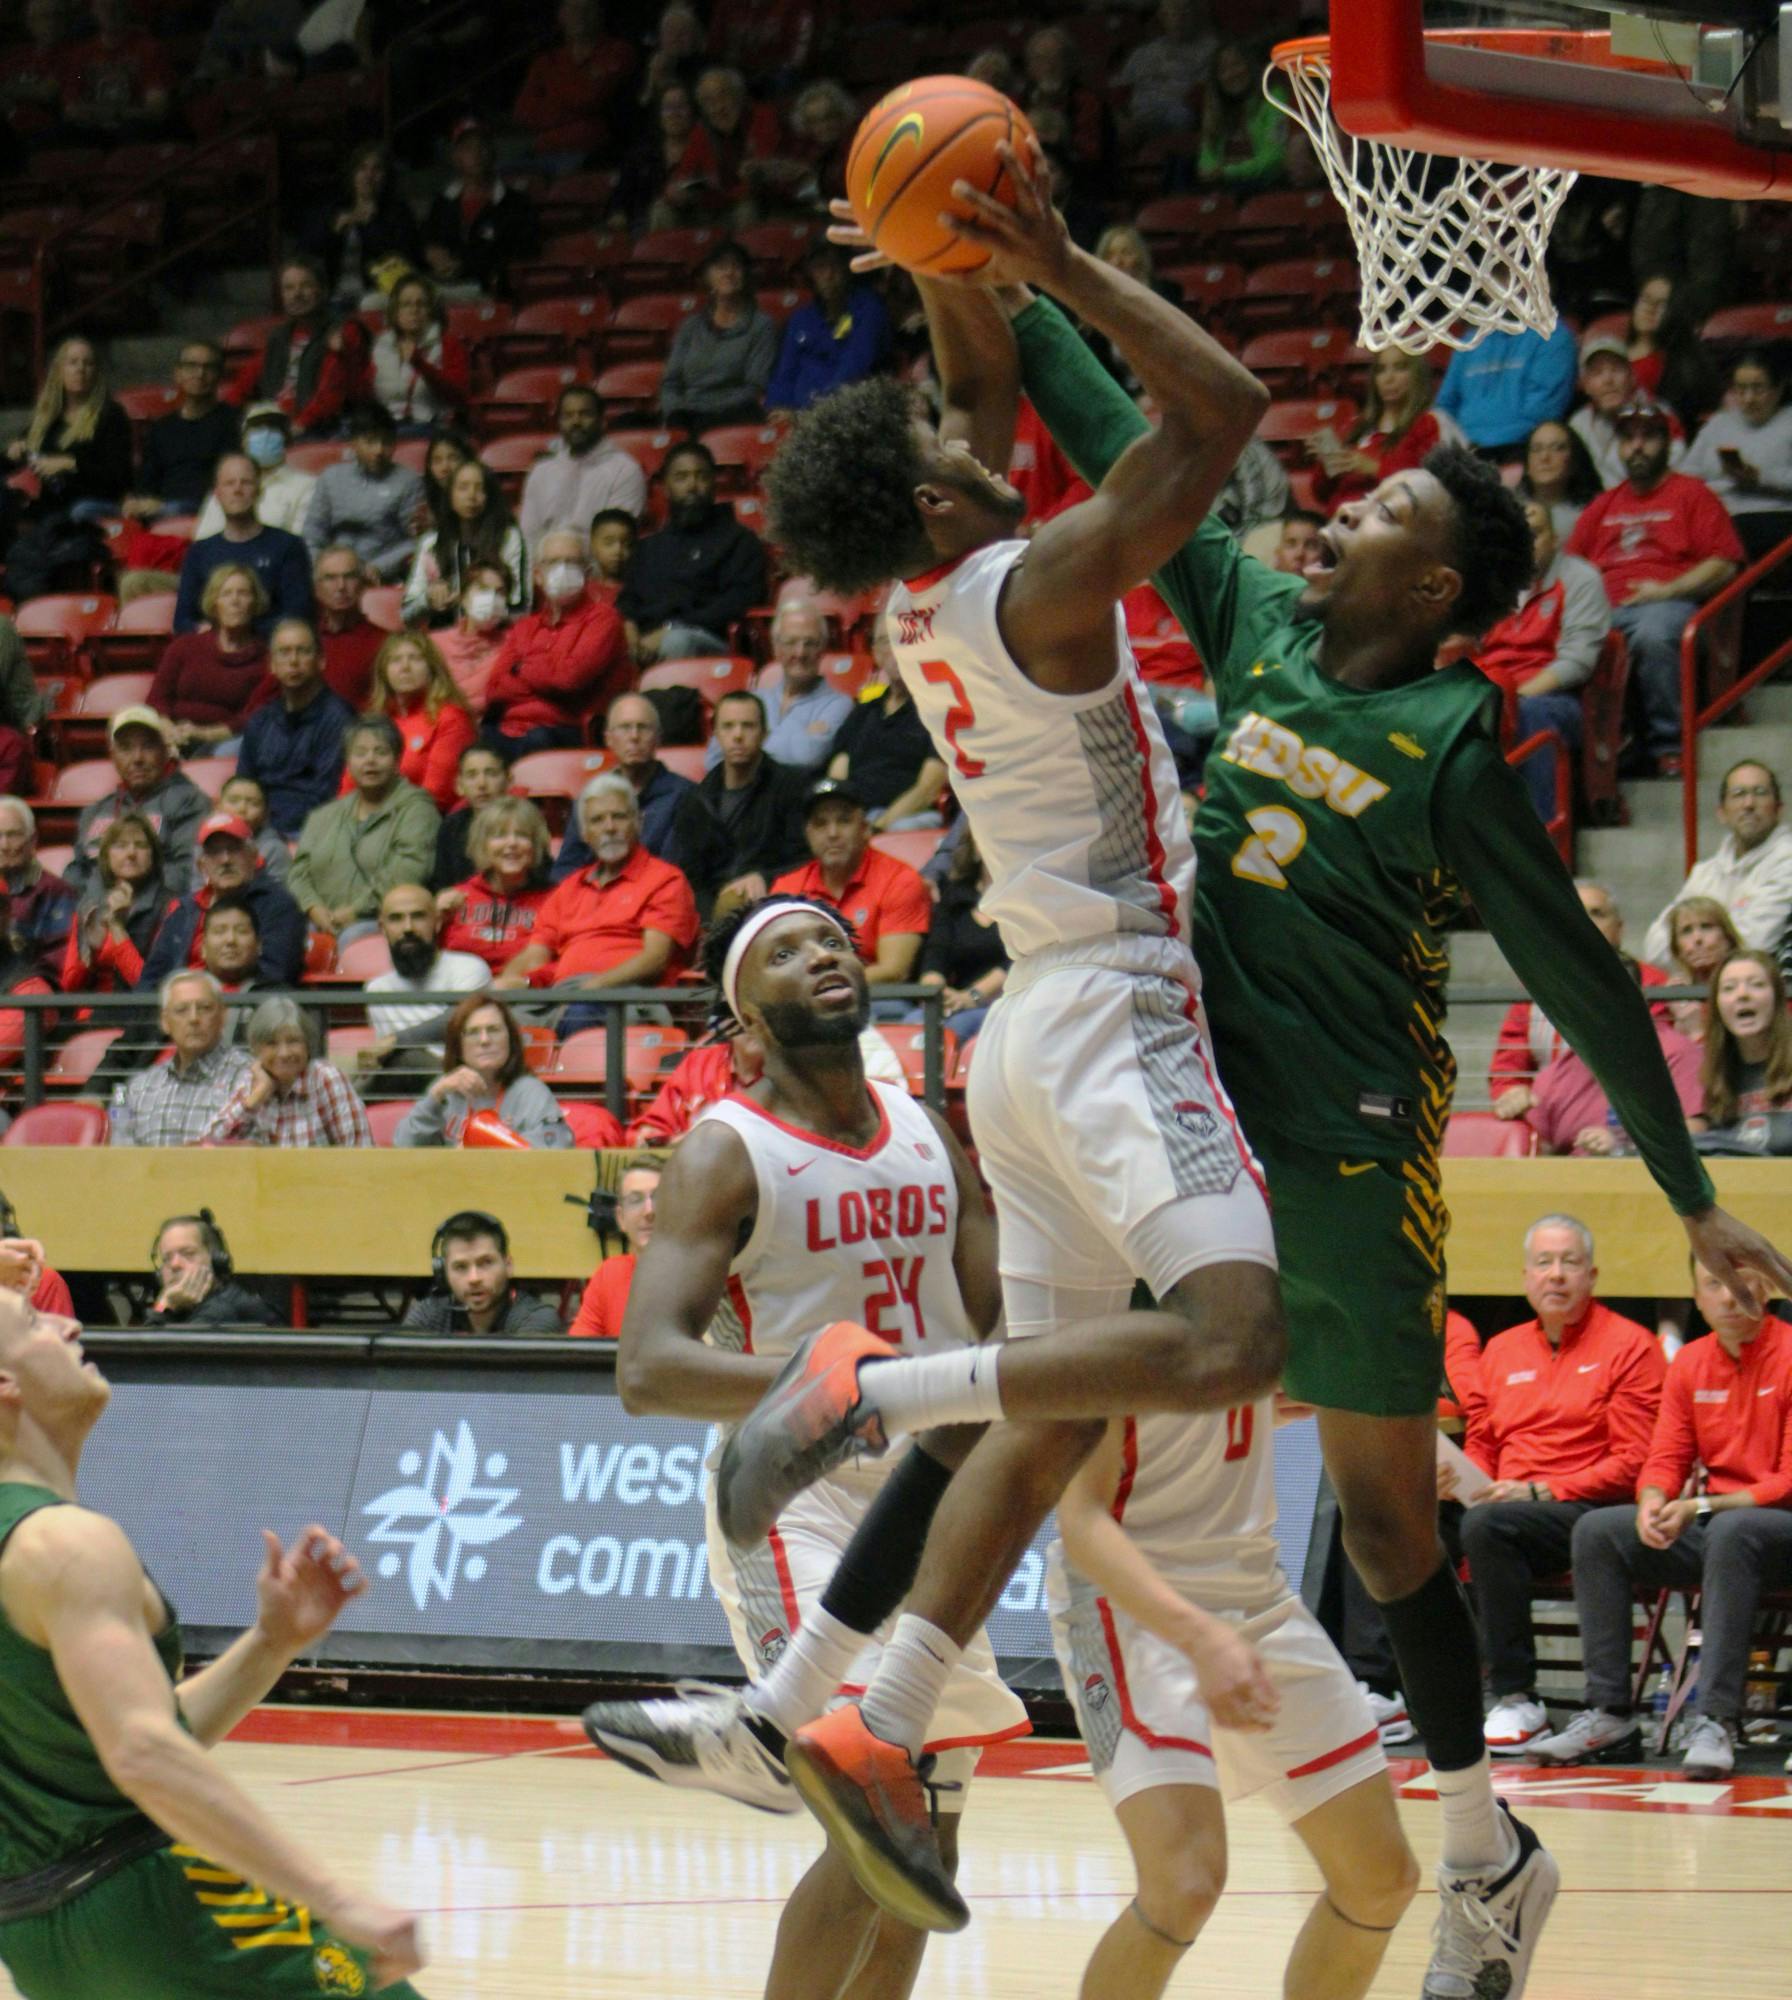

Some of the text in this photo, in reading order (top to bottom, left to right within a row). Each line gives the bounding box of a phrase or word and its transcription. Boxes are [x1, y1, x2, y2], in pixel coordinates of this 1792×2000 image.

[919, 659, 987, 779] 2
[1220, 711, 1391, 818] NDSU
[1231, 804, 1307, 890] 2
[806, 1184, 947, 1253] LOBOS
[862, 1256, 926, 1344] 24
